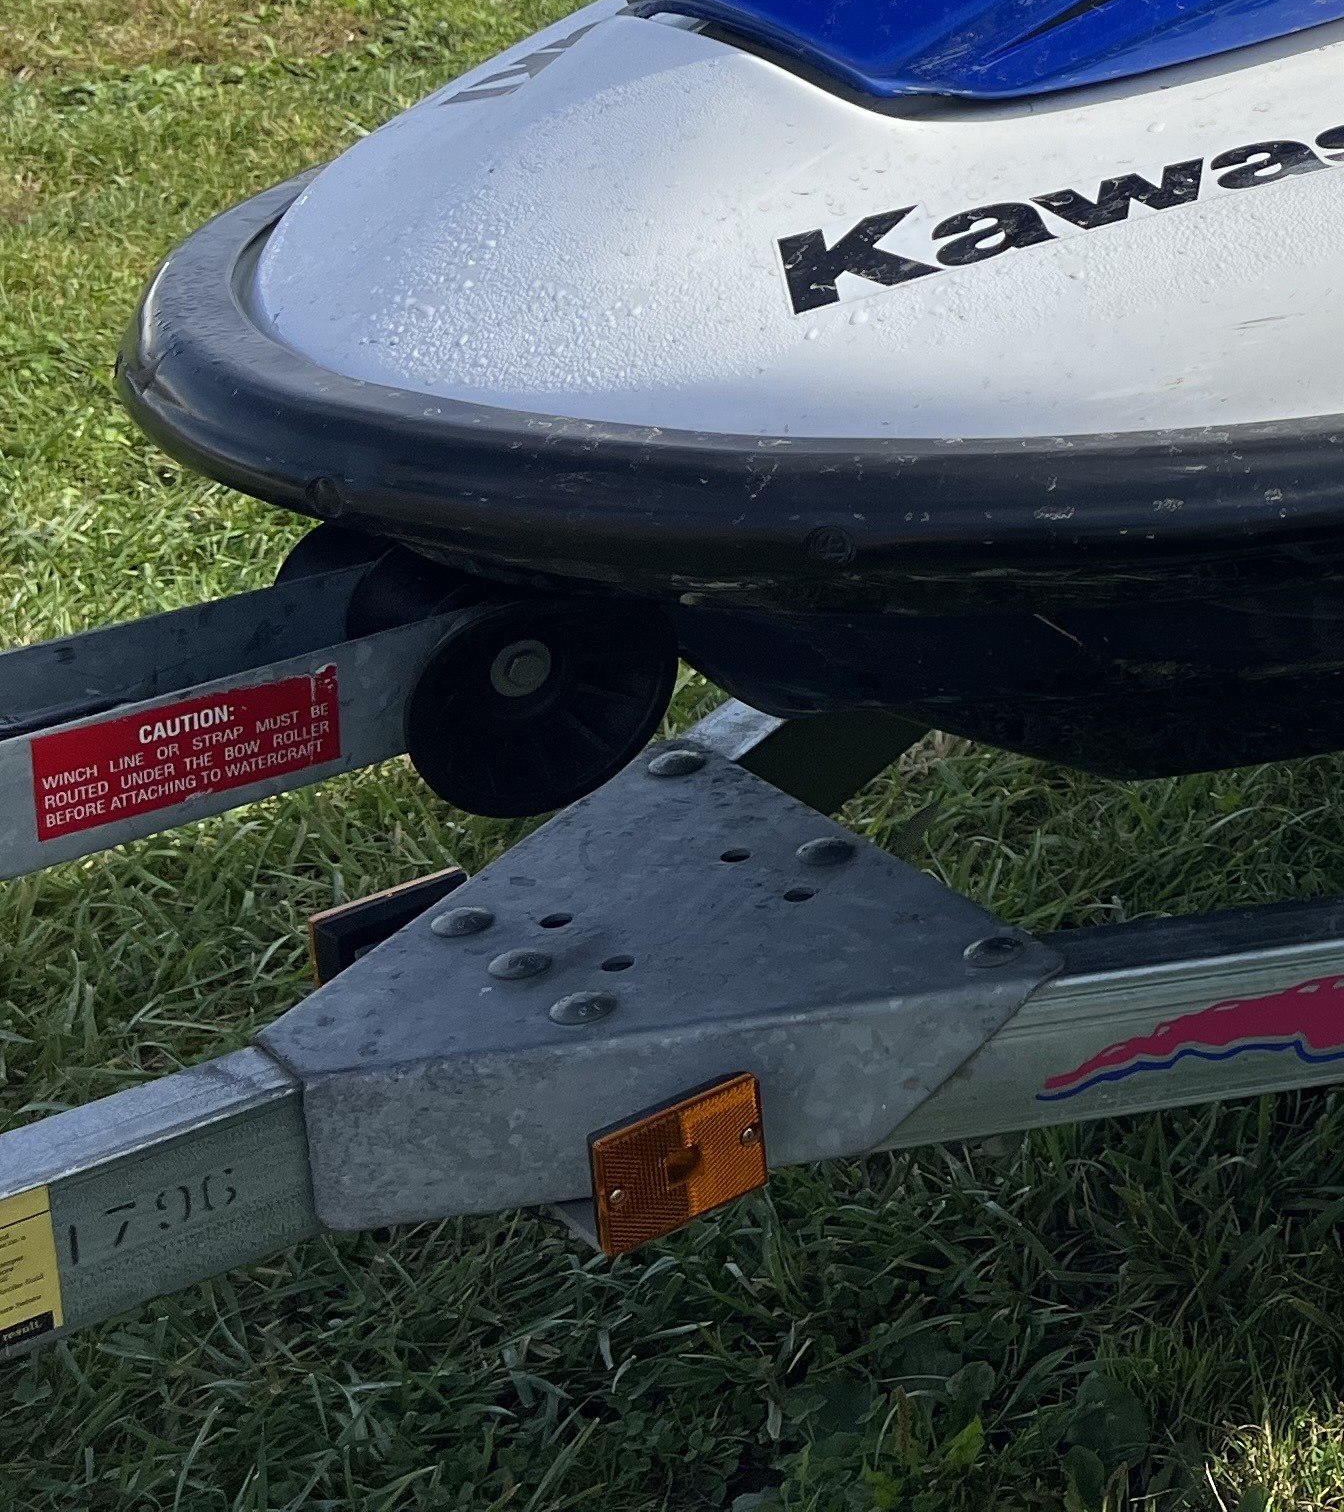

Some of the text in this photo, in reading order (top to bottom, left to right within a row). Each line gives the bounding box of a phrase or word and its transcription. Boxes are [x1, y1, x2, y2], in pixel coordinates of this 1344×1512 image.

[42, 702, 330, 790] WINCH LINE OR STRAP MUST BE
[43, 720, 330, 810] ROUTED UNDER THE BOW ROLLER
[138, 704, 235, 745] CAUTION:
[45, 739, 323, 828] BEFORE ATTACHING TO WATERCRAFT
